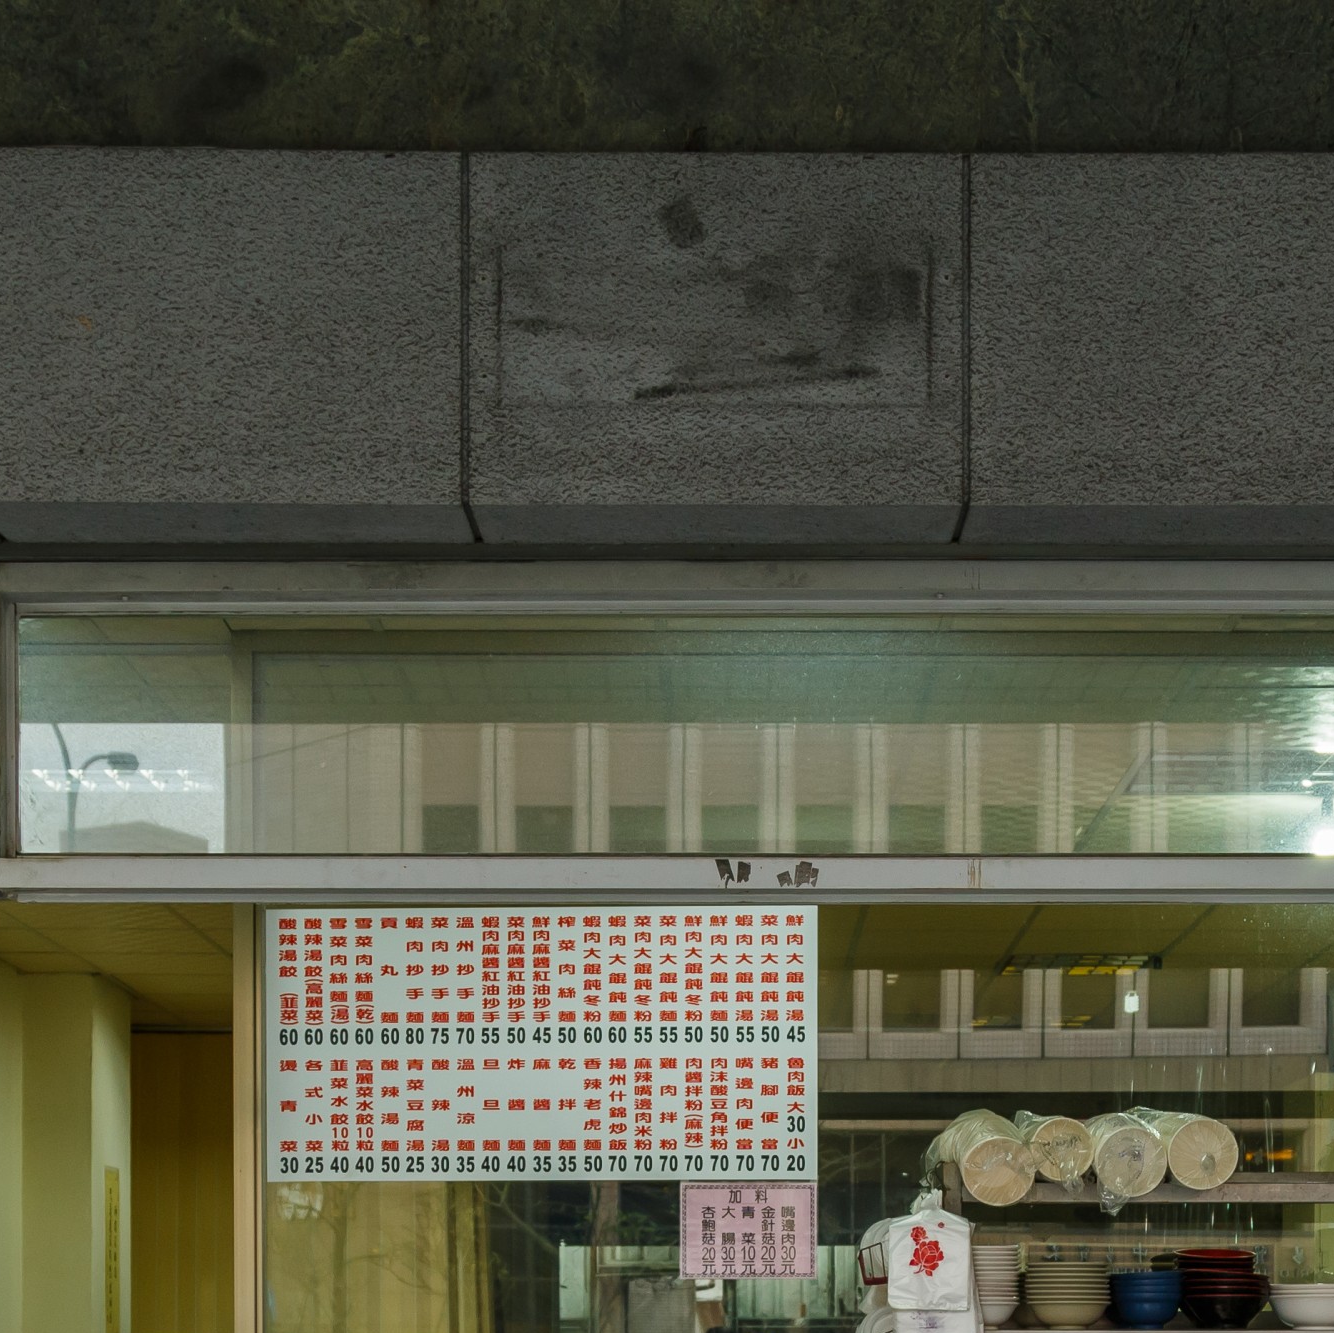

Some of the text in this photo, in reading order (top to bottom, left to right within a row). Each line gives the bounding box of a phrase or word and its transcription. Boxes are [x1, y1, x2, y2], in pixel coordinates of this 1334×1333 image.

[280, 1029, 297, 1045] 60
[305, 1029, 322, 1045] 60
[331, 1029, 348, 1045] 60
[356, 1028, 373, 1044] 60
[381, 1028, 399, 1044] 60
[406, 1028, 423, 1044] 80
[431, 1028, 449, 1044] 75
[457, 1028, 474, 1044] 70
[482, 1028, 499, 1043] 55
[508, 1028, 525, 1043] 50
[533, 1028, 551, 1043] 45
[559, 1027, 576, 1043] 50
[584, 1027, 602, 1043] 60
[609, 1027, 626, 1043] 60
[635, 1027, 652, 1042] 55
[660, 1027, 677, 1043] 55
[685, 1027, 702, 1042] 50
[711, 1027, 728, 1042] 50
[737, 1027, 754, 1042] 55
[762, 1026, 779, 1042] 50
[787, 1026, 805, 1042] 45
[788, 1116, 805, 1132] 30
[787, 1138, 804, 1150] 小
[281, 1157, 298, 1173] 30
[306, 1157, 323, 1173] 25
[331, 1157, 348, 1173] 40
[356, 1157, 373, 1172] 40
[382, 1157, 399, 1172] 50
[407, 1157, 424, 1172] 25
[432, 1156, 449, 1172] 30
[457, 1157, 474, 1172] 35
[482, 1156, 499, 1172] 40
[507, 1156, 525, 1172] 40
[534, 1156, 551, 1172] 35
[559, 1156, 576, 1172] 35
[585, 1156, 602, 1171] 50
[609, 1156, 626, 1171] 70
[635, 1156, 652, 1171] 70
[660, 1156, 677, 1171] 70
[685, 1155, 702, 1171] 70
[711, 1155, 728, 1171] 70
[737, 1155, 754, 1171] 70
[762, 1155, 779, 1171] 70
[787, 1155, 805, 1171] 20
[729, 1189, 768, 1204] 加料
